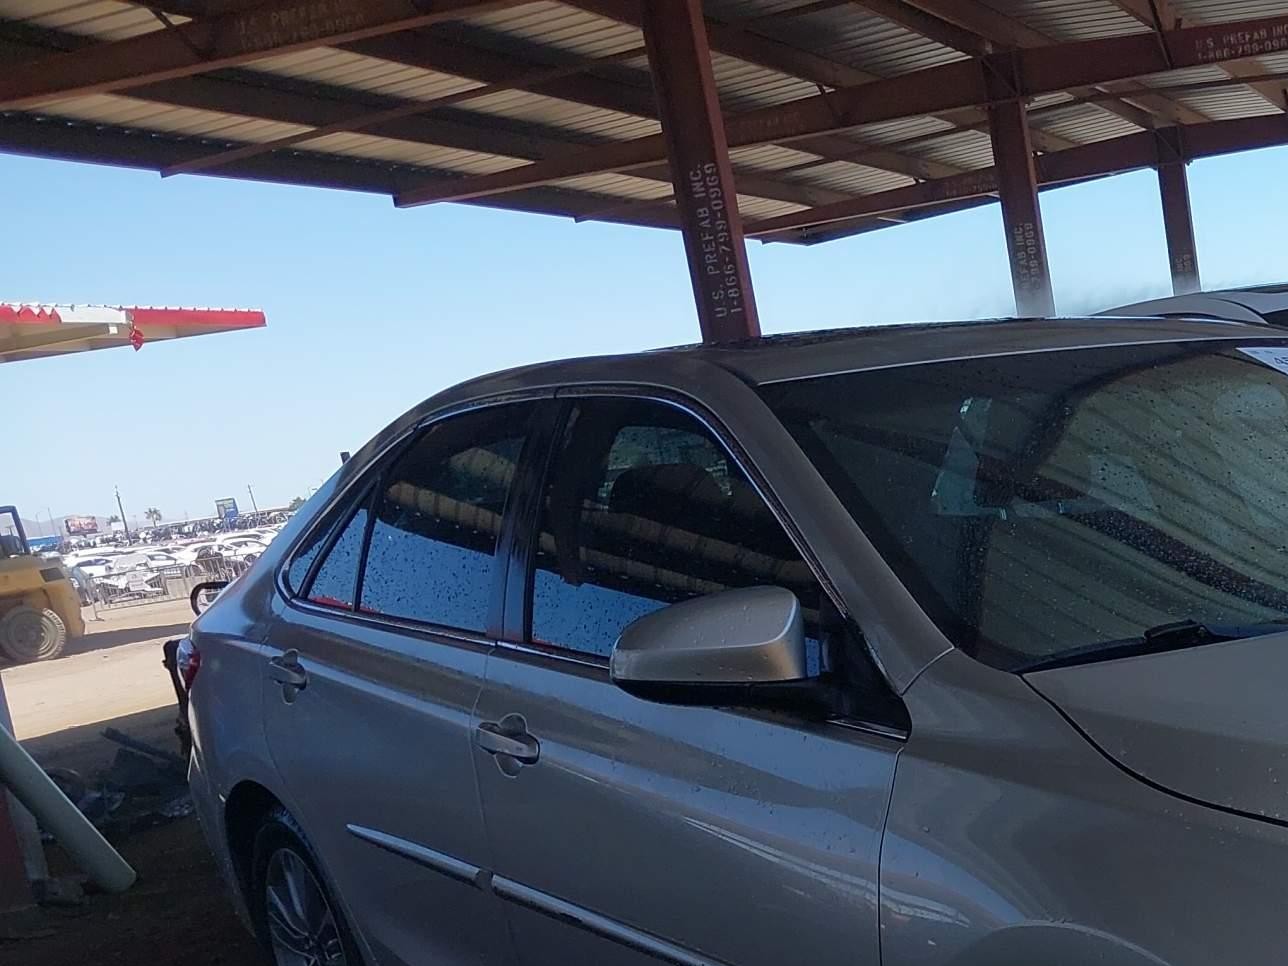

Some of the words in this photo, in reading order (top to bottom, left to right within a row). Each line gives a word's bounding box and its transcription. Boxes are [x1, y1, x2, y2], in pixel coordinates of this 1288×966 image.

[1222, 28, 1268, 46] PREFAB
[688, 162, 706, 199] INC.
[695, 206, 721, 275] PREFAB
[703, 162, 743, 314] 1-866-799-0969
[710, 283, 728, 318] U.S.
